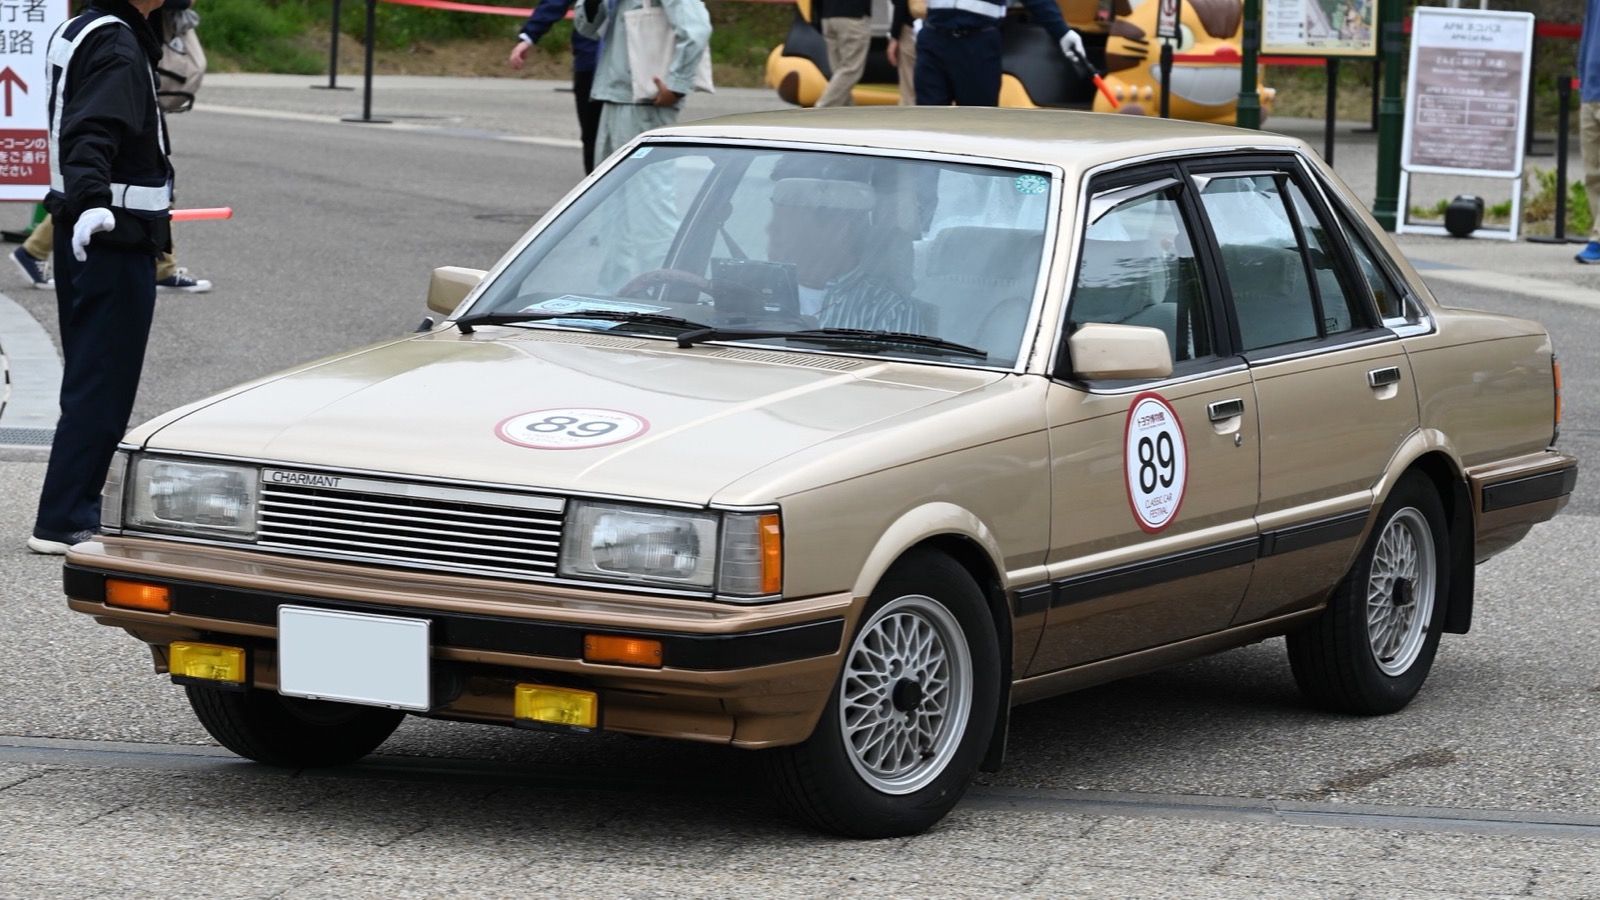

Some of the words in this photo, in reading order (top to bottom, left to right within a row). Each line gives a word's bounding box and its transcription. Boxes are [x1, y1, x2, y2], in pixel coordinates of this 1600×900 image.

[526, 416, 618, 437] 89
[1138, 431, 1175, 494] 89
[272, 471, 342, 487] CHARMANT
